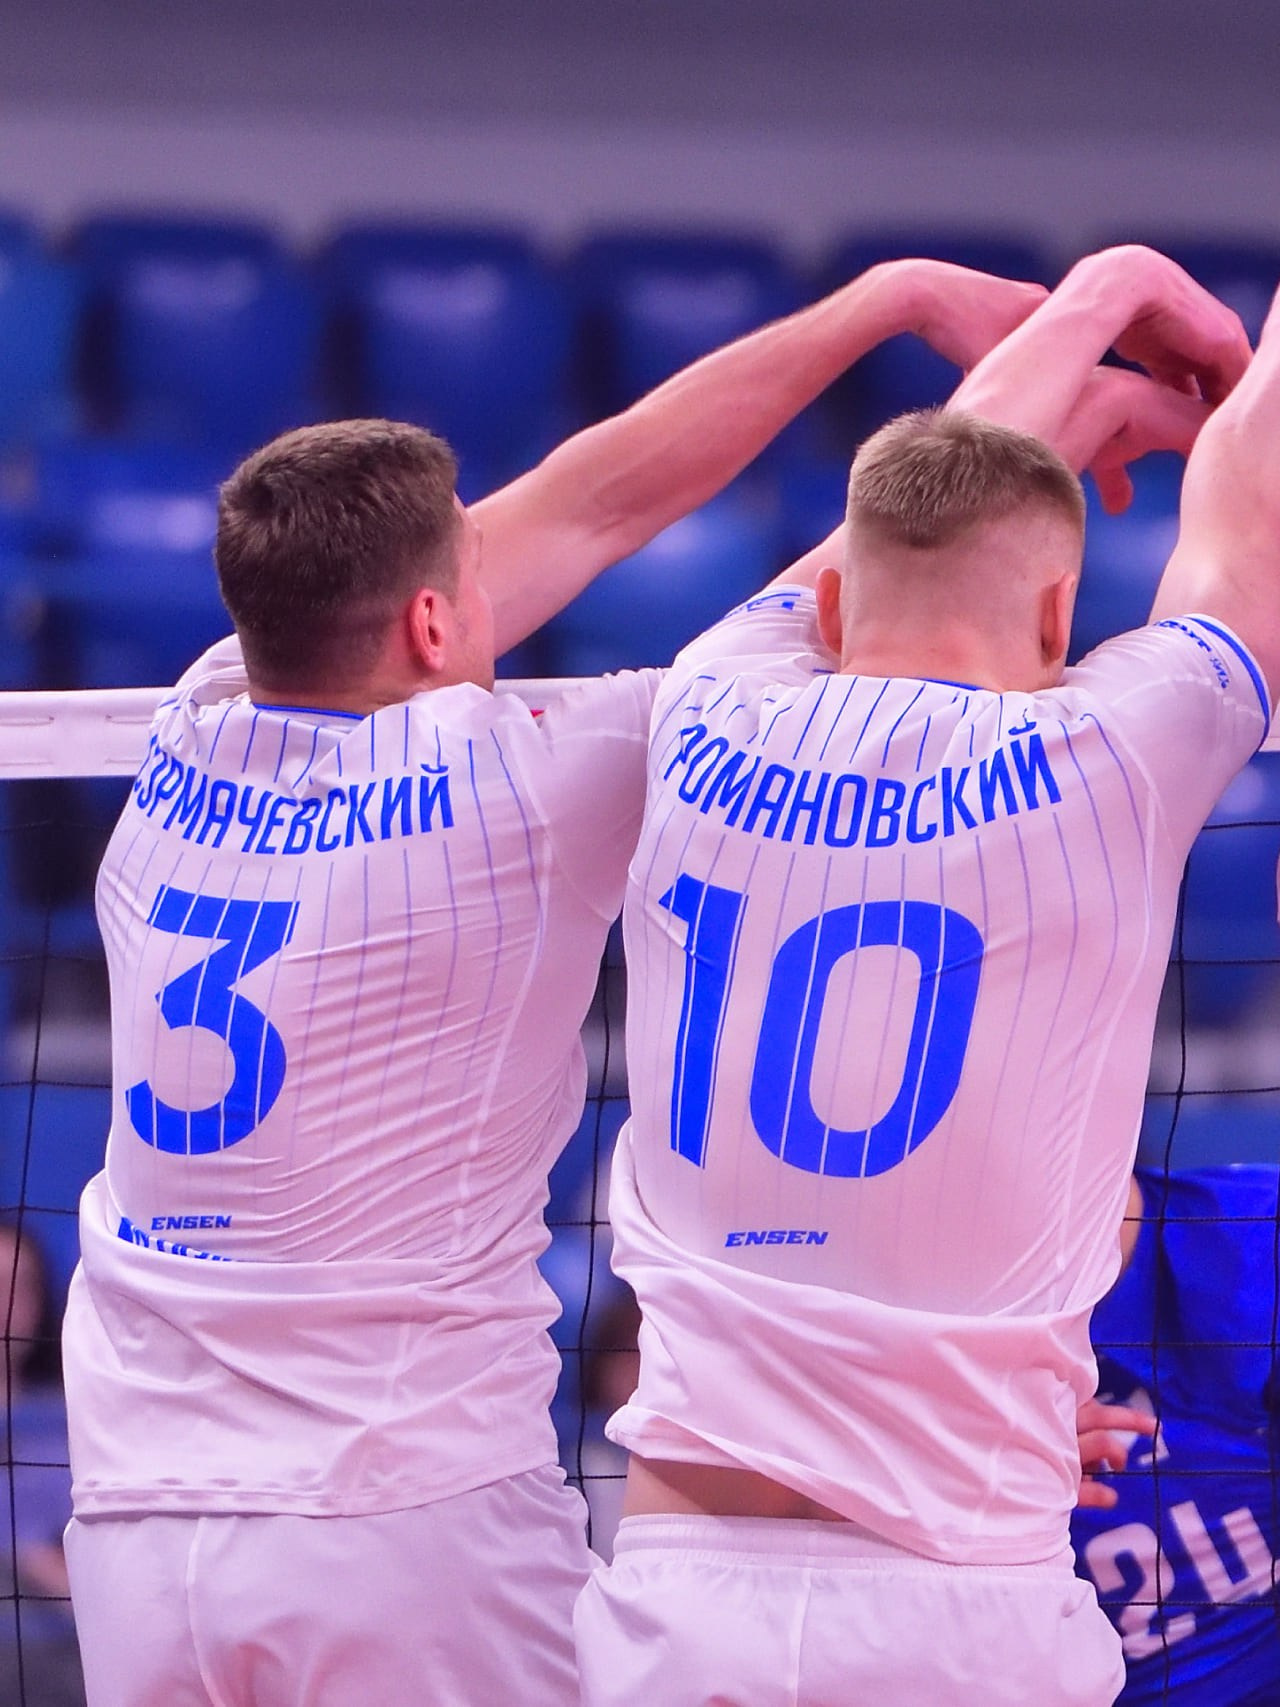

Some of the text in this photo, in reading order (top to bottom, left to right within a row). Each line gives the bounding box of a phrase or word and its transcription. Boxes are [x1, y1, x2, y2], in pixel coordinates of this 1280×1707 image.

[663, 716, 1062, 849] РОМАНОВСКИЙ
[125, 884, 300, 1155] 3
[658, 872, 985, 1178] 10
[151, 1215, 232, 1231] ENSEN
[725, 1230, 829, 1248] ENSEN
